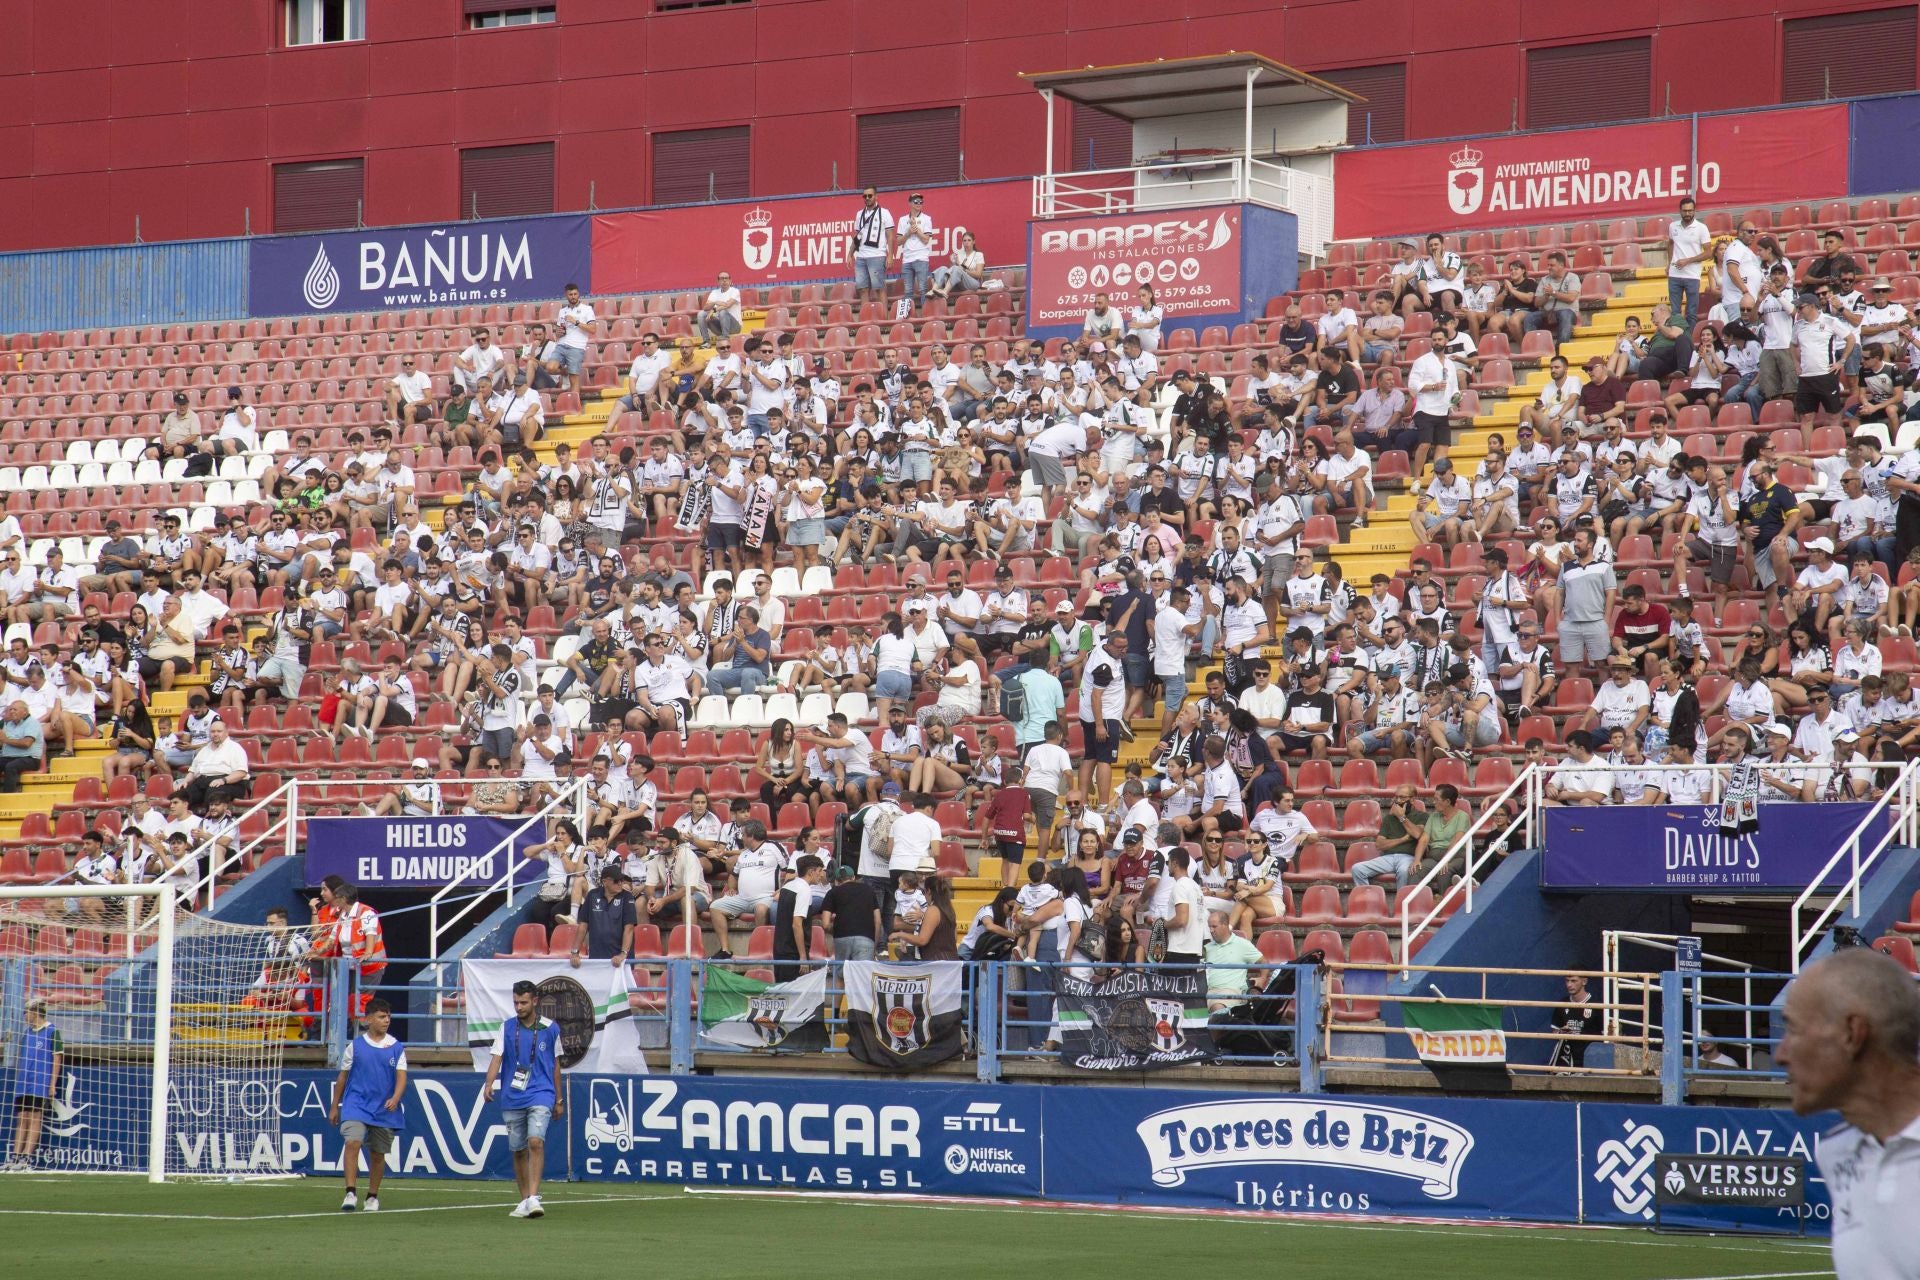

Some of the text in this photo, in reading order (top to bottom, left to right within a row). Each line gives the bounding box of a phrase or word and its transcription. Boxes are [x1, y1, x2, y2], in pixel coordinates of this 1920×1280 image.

[1495, 157, 1590, 179] AYUNTAMIENTO
[783, 220, 856, 237] AYUNTAMIENT
[1041, 218, 1208, 253] BORPEX
[359, 228, 533, 291] BAÑUM
[1093, 243, 1205, 260] INSTALACIONES
[383, 286, 507, 305] www.bañum.es
[1057, 294, 1078, 305] 675
[1165, 287, 1187, 298] 579
[1189, 285, 1212, 296] 653
[386, 823, 467, 848] HIELOS
[358, 856, 494, 881] EL DANUBIO
[1666, 872, 1760, 884] BARBER SHOP & TATTOO
[1097, 972, 1149, 997] AUGUSTA
[642, 1080, 921, 1158] ZAMCAR
[943, 1116, 1026, 1133] STILL
[1159, 1109, 1449, 1167] Torres de Briz
[969, 1147, 1013, 1161] Nilfisk
[969, 1160, 1026, 1174] Advance
[1688, 1164, 1797, 1186] VERSUS
[1235, 1180, 1370, 1210] Ibéricos
[1702, 1186, 1787, 1198] E-LEARNING
